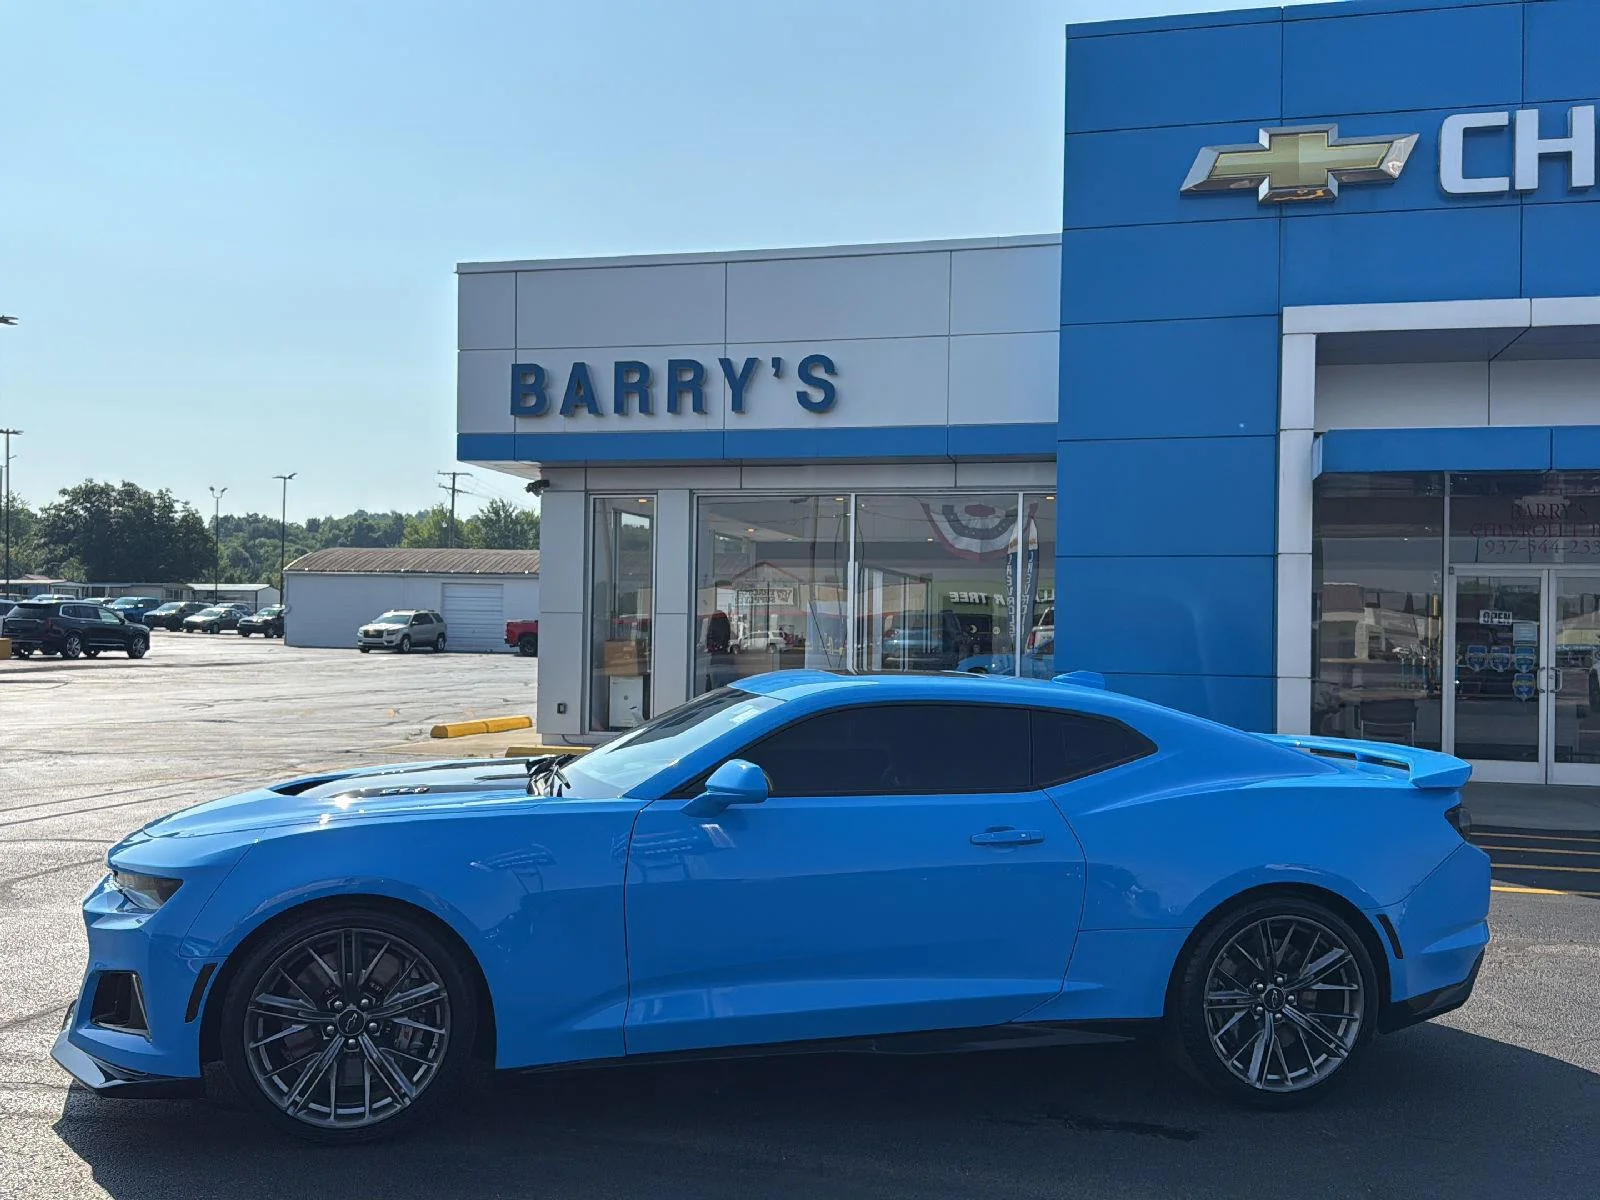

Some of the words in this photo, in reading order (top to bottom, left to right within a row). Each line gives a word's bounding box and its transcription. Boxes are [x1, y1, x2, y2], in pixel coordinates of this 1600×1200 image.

[1440, 105, 1596, 194] CH
[510, 354, 838, 417] BARRY'S
[1483, 611, 1511, 624] OPEN
